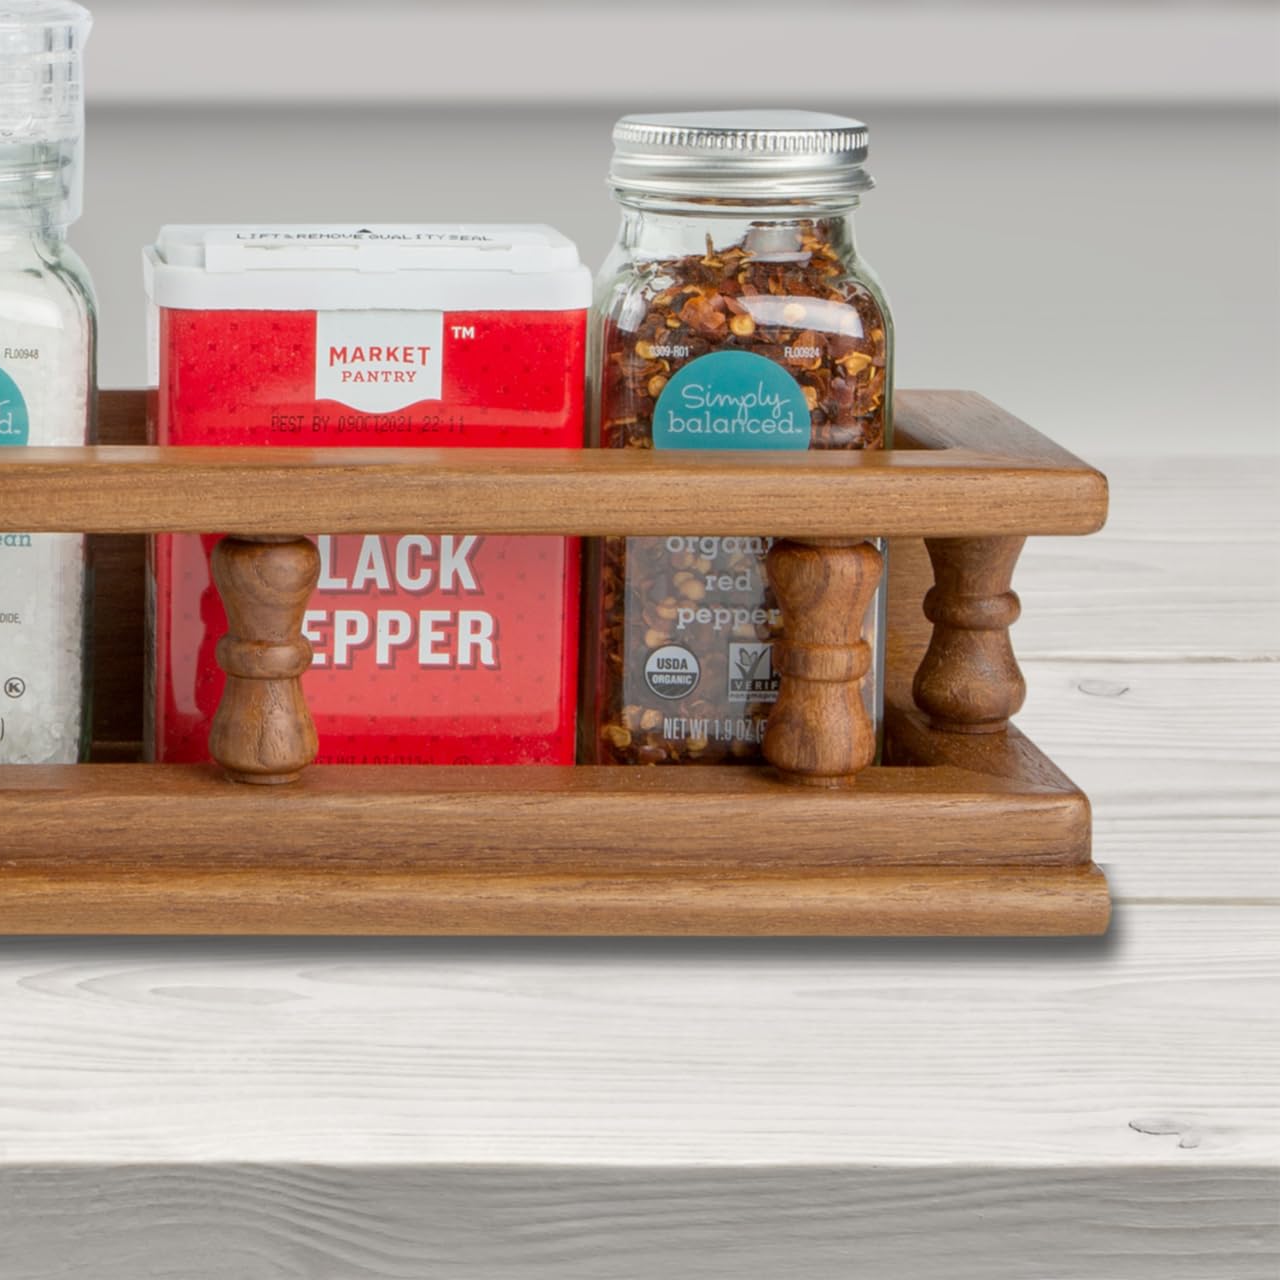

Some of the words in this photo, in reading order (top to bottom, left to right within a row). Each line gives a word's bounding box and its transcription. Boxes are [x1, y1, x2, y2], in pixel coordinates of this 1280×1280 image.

[329, 346, 431, 367] MARKET
[341, 371, 417, 383] PANTRY
[681, 381, 790, 422] Simply
[271, 415, 305, 433] BEST
[312, 415, 331, 433] BY
[666, 536, 774, 560] organ
[317, 534, 478, 591] LACK
[705, 569, 752, 591] red
[677, 607, 781, 630] pepper
[301, 610, 495, 665] EPPER
[656, 657, 689, 670] USDA
[652, 674, 693, 685] ORGANIC
[735, 680, 779, 690] VERIF
[663, 718, 687, 739] NET
[689, 719, 709, 740] WT
[735, 719, 753, 741] OZ
